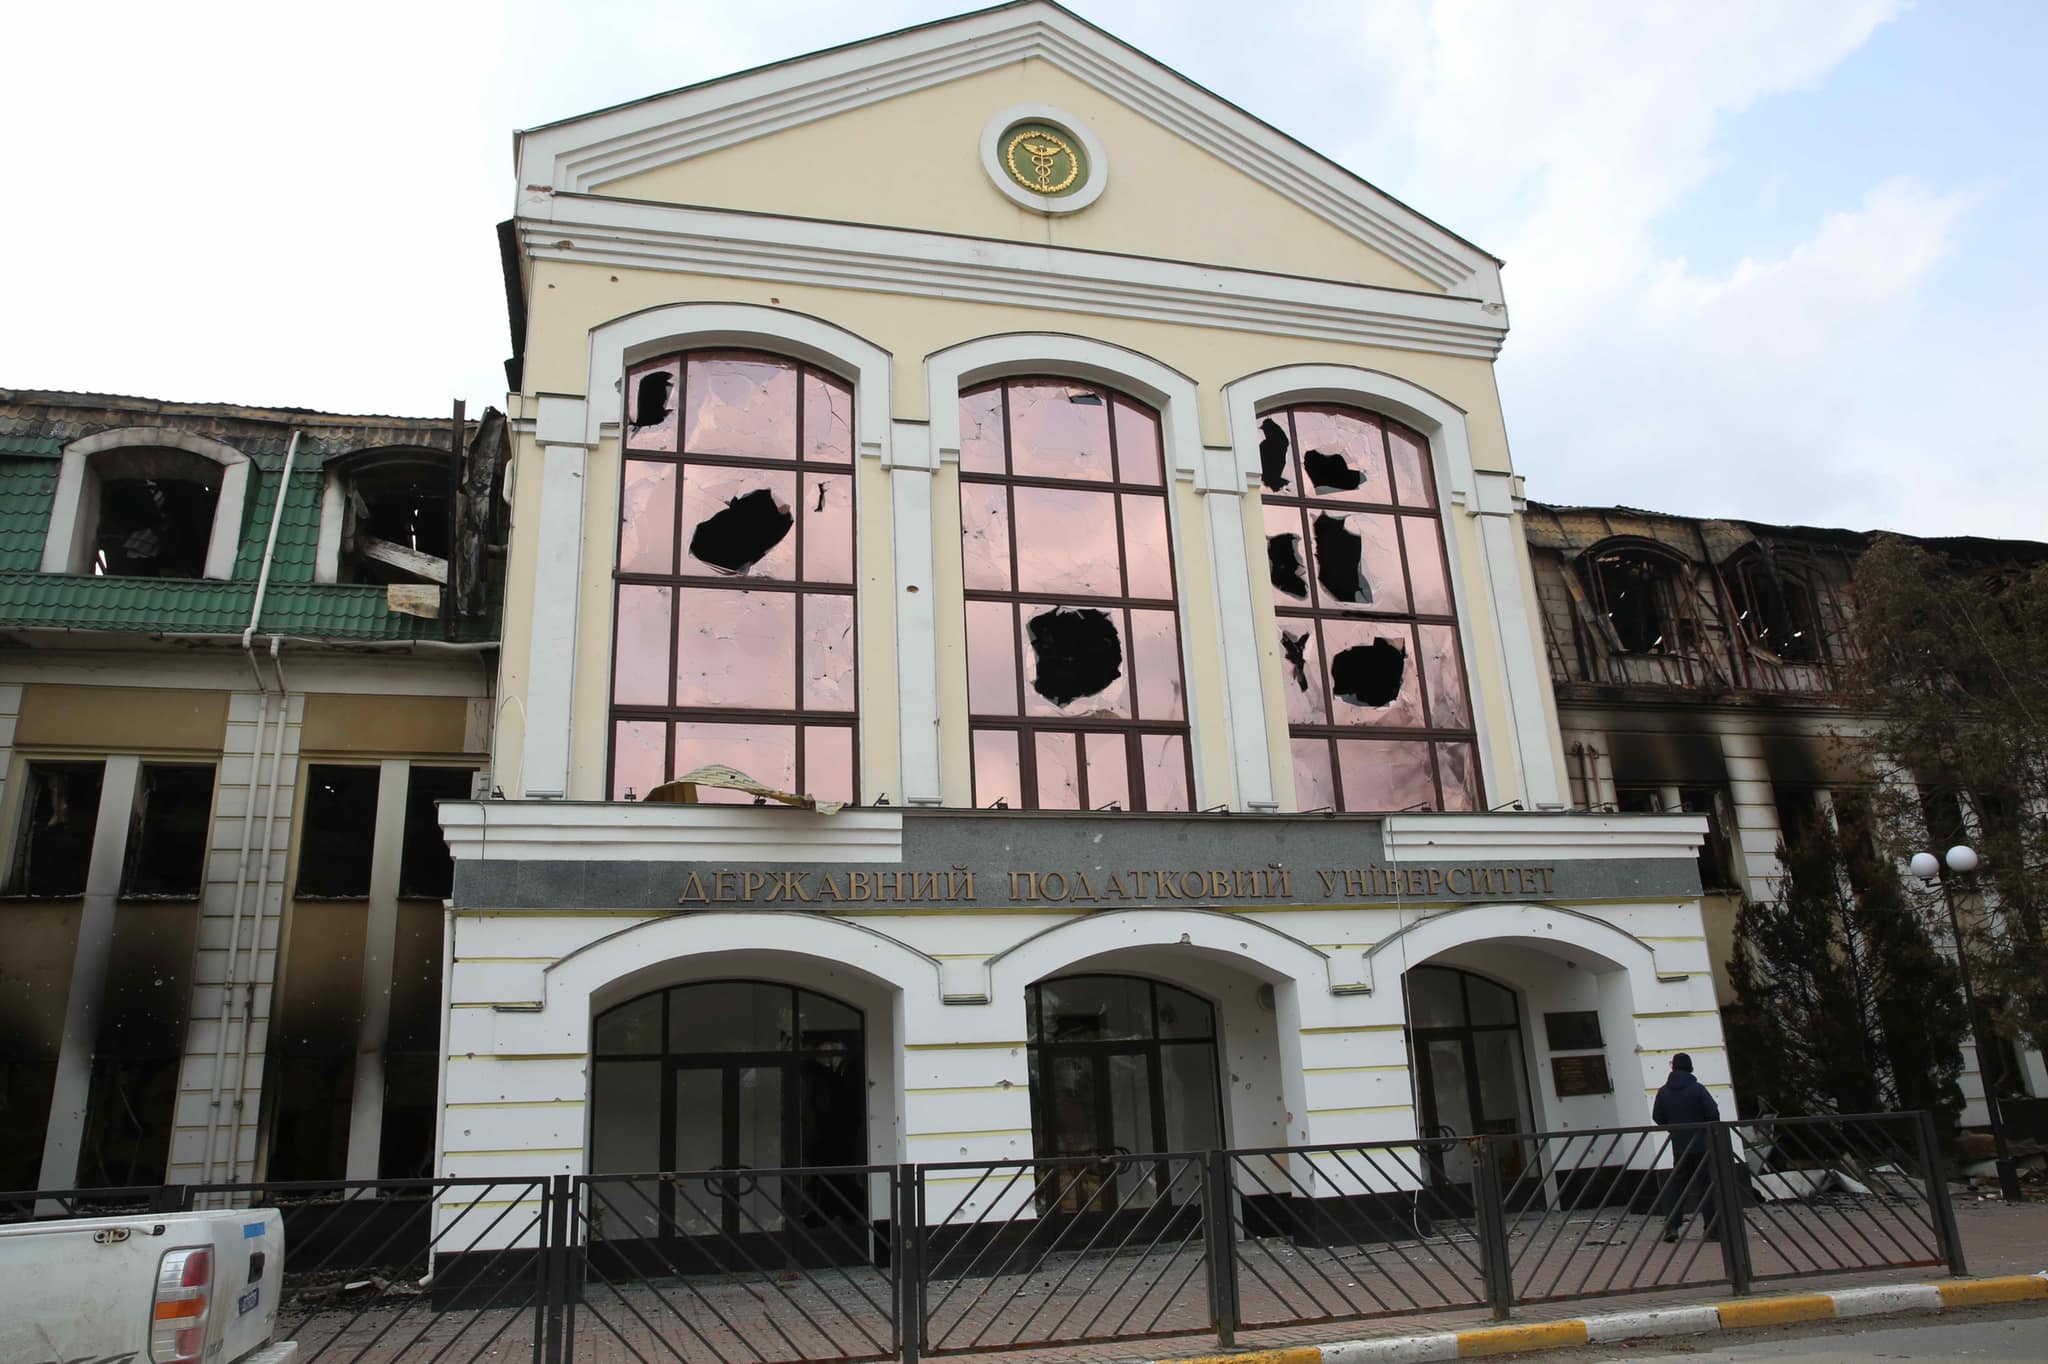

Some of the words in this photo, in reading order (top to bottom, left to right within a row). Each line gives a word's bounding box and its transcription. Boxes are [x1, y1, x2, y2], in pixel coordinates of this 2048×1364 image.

[679, 864, 977, 903] ДЕРЖАВНИЙ
[1007, 863, 1293, 902] ПОДАТКОВИЙ
[1316, 864, 1556, 898] УНІВЕРСИТЕТ
